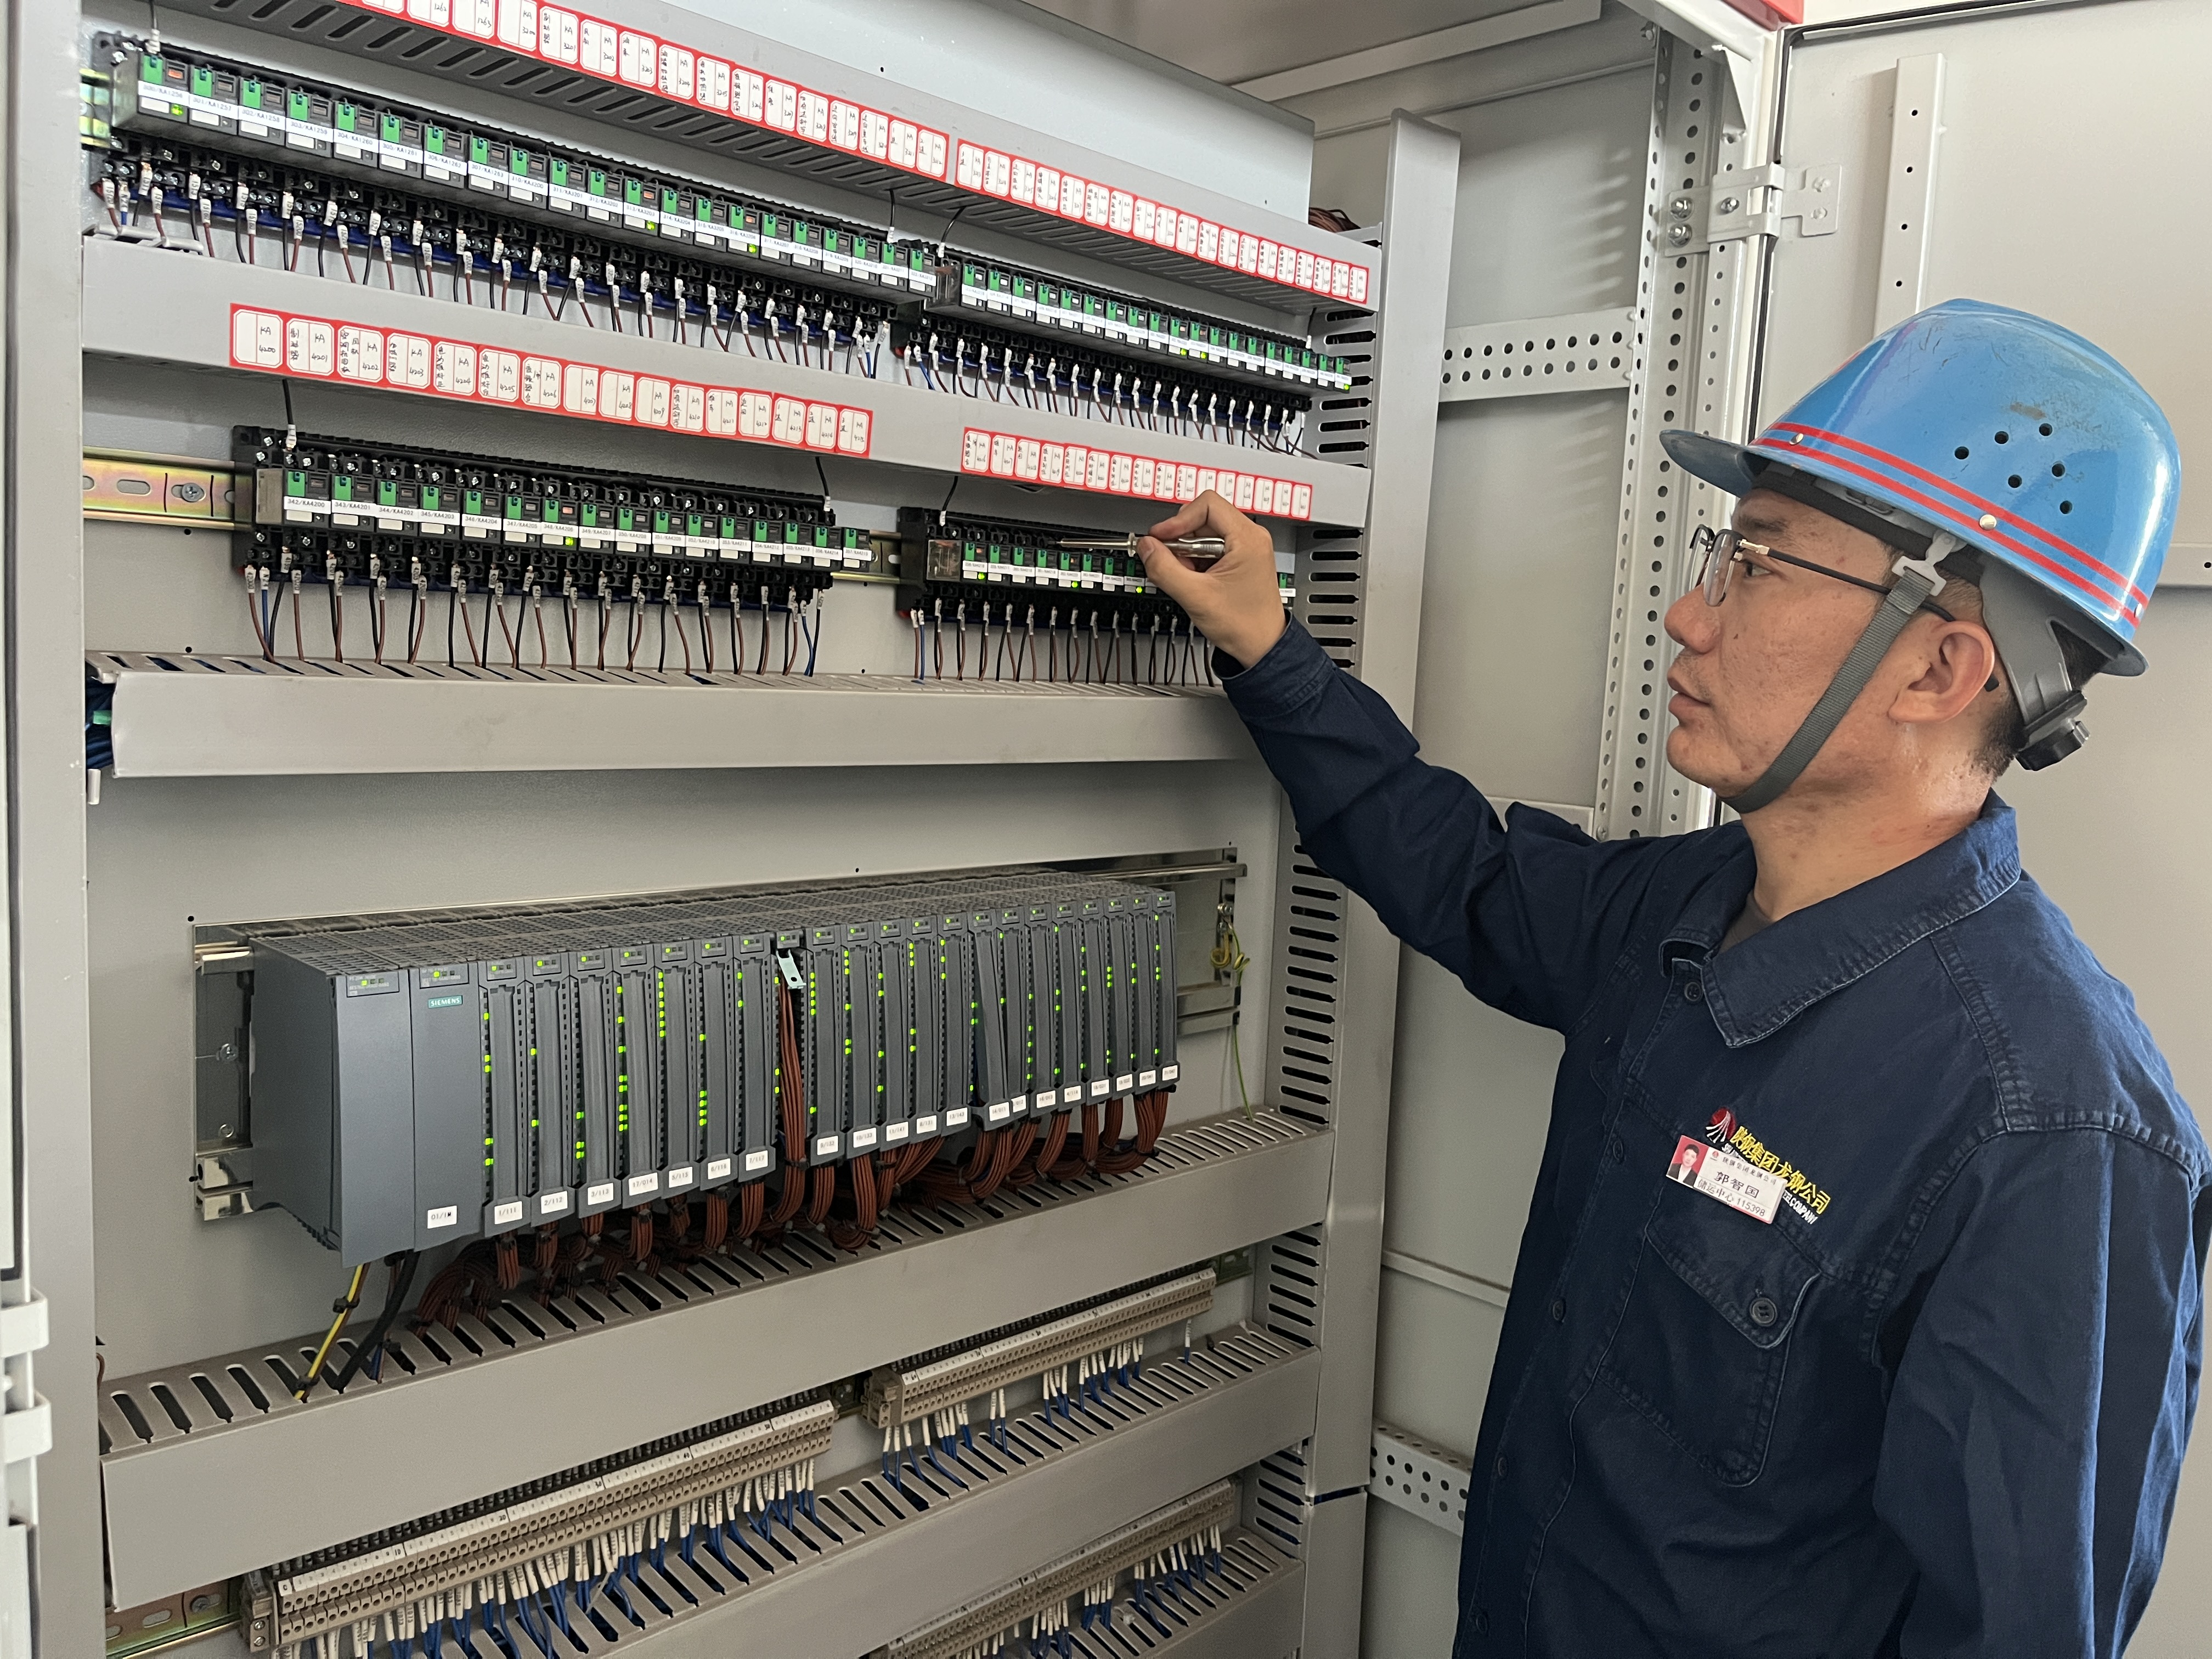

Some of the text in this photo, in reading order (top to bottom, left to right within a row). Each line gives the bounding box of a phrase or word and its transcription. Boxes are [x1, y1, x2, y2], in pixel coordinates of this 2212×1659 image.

[522, 9, 533, 21] KA
[565, 25, 573, 35] KA
[604, 36, 612, 46] KA
[641, 47, 650, 56] KA
[193, 97, 231, 111] 301/KA1257
[241, 108, 280, 123] 302/KA1258
[290, 120, 328, 135] 303/KA1259
[337, 132, 373, 146] 304/KA1260
[382, 143, 417, 156] 305/KA1261
[260, 326, 272, 335] KA
[314, 333, 325, 343] KA
[258, 345, 276, 353] 4200
[367, 342, 377, 352] KA
[311, 352, 328, 362] 4201
[411, 348, 423, 357] KA
[362, 362, 379, 371] 4202
[458, 357, 470, 366] KA
[409, 368, 425, 377] 4203
[503, 365, 512, 375] KA
[455, 377, 472, 386] 4204
[546, 372, 555, 381] KA
[500, 383, 516, 393] 4205
[622, 384, 631, 393] KA
[543, 389, 557, 398] 4206
[287, 498, 325, 508] 342/KA4200
[335, 501, 370, 511] 343/KA4201
[379, 506, 413, 516] 344/KA4202
[421, 510, 454, 520] 345/KA4203
[465, 515, 498, 524] 346/KA4204
[506, 520, 538, 529] 347/KA4205
[544, 523, 573, 532] 348/KA4206
[581, 527, 611, 537] 349/KA4207
[430, 997, 460, 1006] SIEMENS
[1729, 1125, 1831, 1215] 陕钢集团龙钢公司
[1713, 1171, 1760, 1198] 郭智国
[1697, 1178, 1766, 1217] 储运中心 115398
